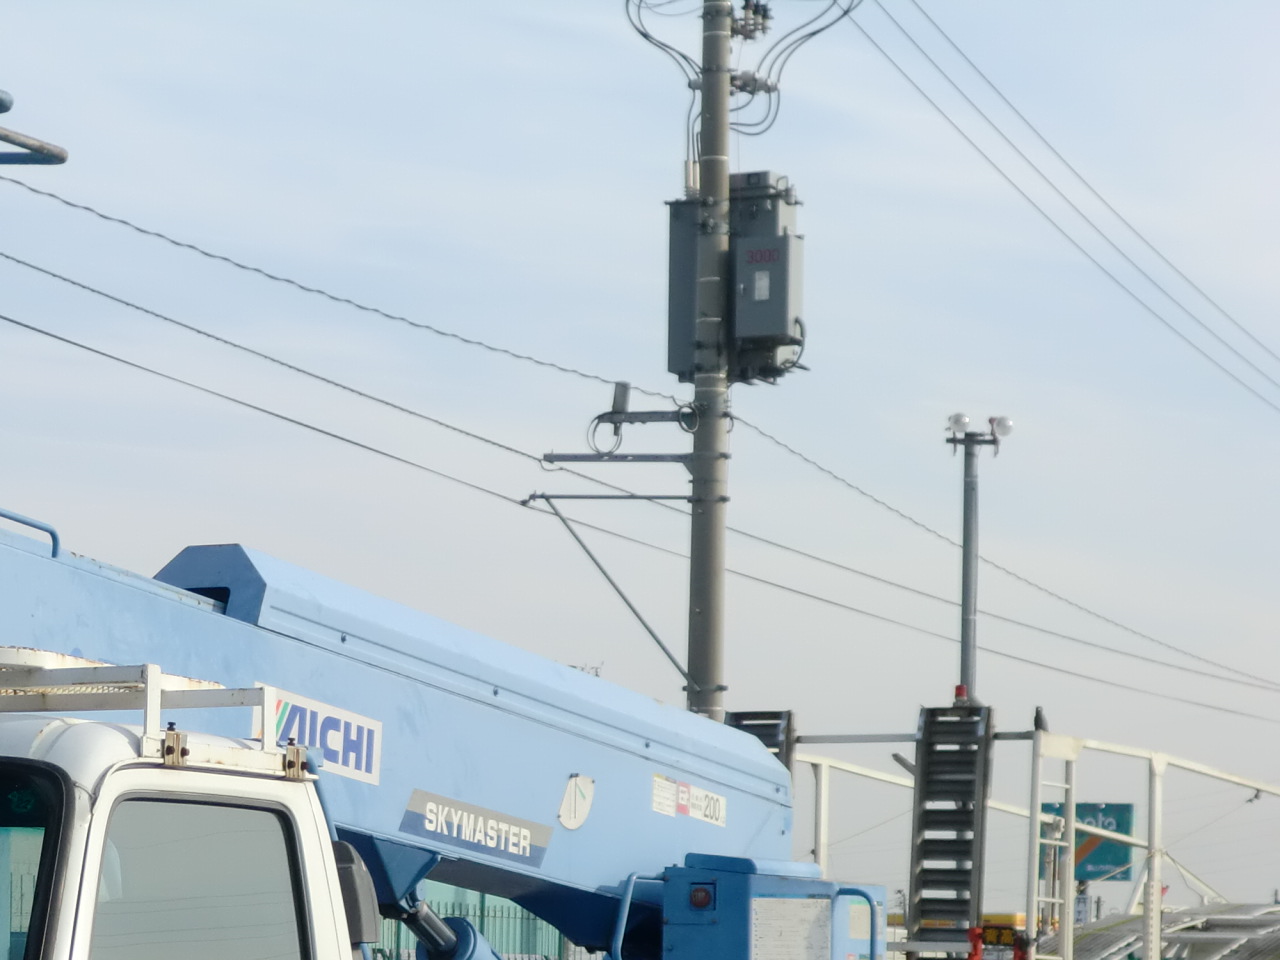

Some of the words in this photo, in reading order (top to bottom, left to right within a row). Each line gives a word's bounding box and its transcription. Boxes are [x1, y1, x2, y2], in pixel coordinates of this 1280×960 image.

[276, 702, 375, 775] AICHI
[425, 801, 531, 857] SKYMASTER
[703, 794, 721, 822] 200
